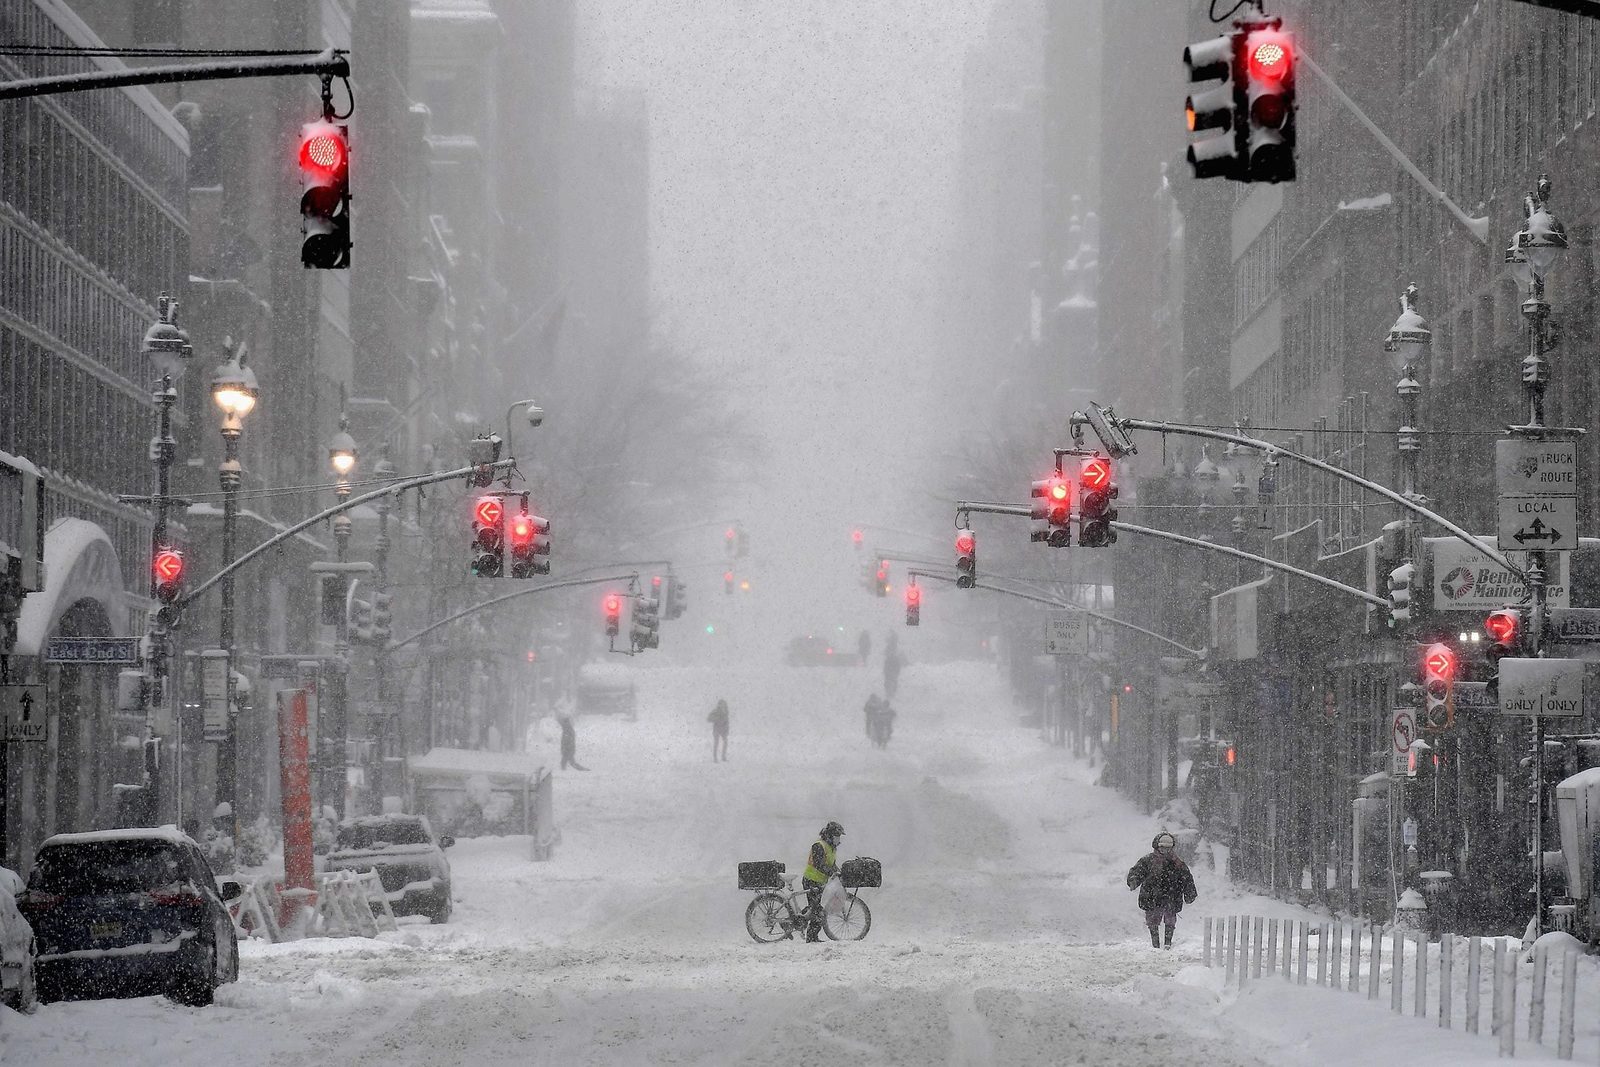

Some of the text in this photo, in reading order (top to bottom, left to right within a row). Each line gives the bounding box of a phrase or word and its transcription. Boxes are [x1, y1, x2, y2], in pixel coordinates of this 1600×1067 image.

[1540, 453, 1573, 464] TRUCK
[1540, 472, 1573, 483] ROUTE
[1518, 502, 1557, 513] LOCAL
[1054, 621, 1080, 629] BUSES
[1056, 630, 1078, 639] ONLY
[49, 646, 78, 659] East
[82, 646, 114, 659] 42nd
[1505, 699, 1578, 711] ONLY ONLY
[11, 724, 42, 736] ONLY
